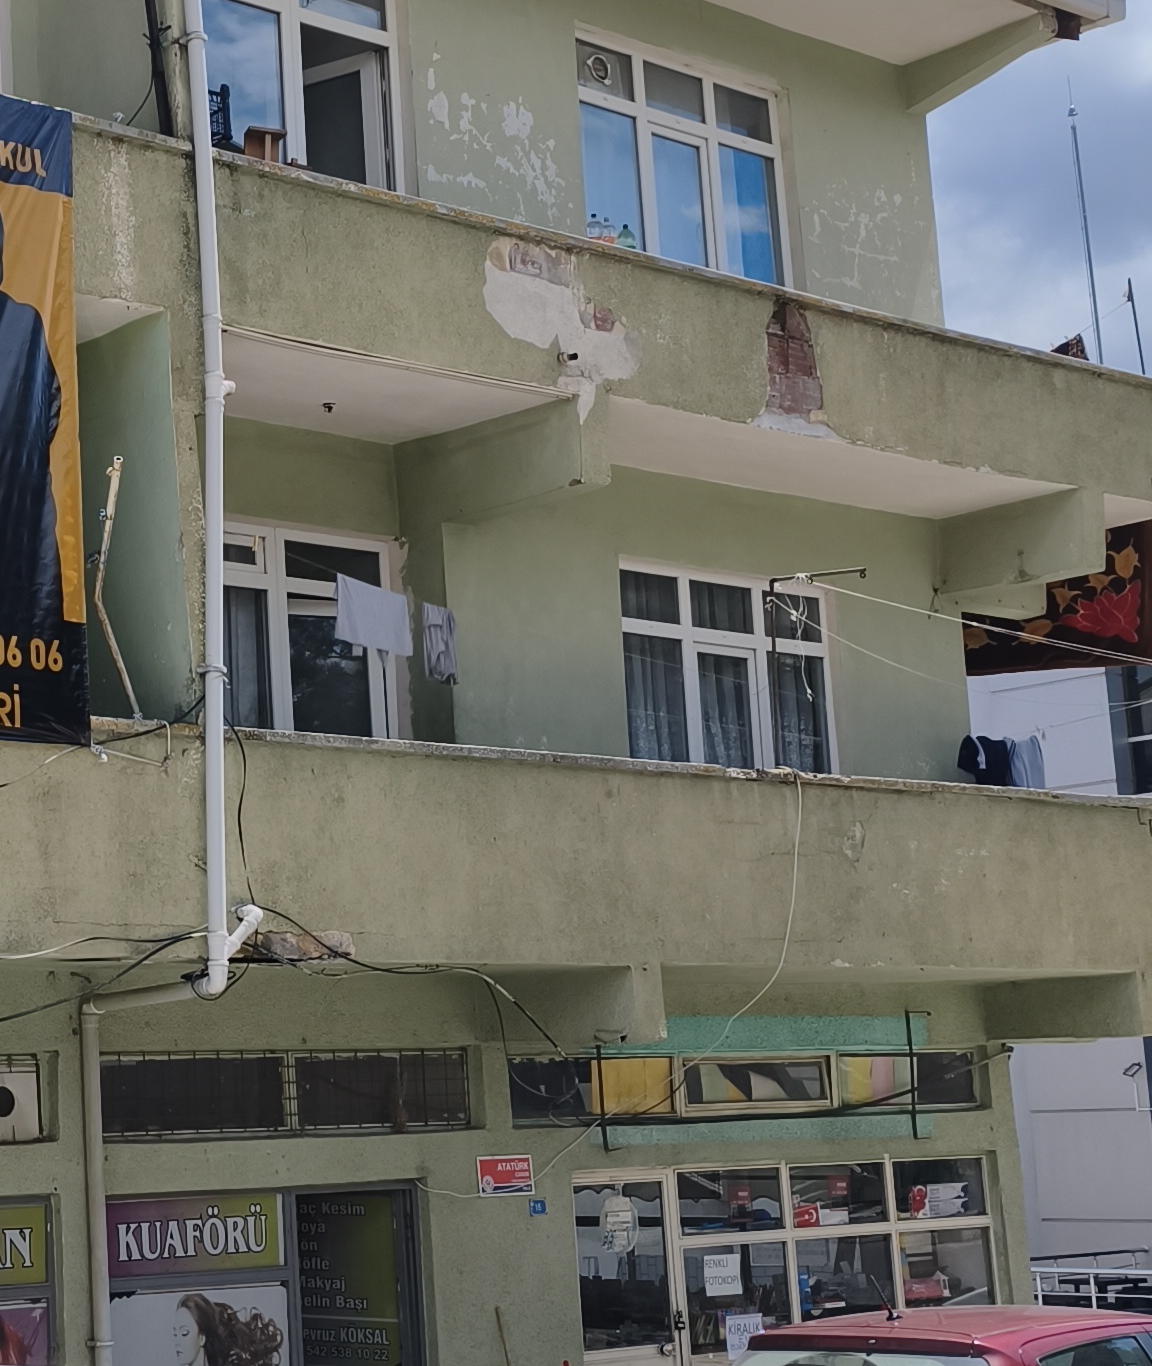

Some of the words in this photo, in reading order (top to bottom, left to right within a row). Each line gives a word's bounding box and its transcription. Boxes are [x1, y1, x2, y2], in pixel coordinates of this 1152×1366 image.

[30, 638, 63, 672] 06
[497, 1160, 529, 1171] ATATÜRK
[298, 1204, 316, 1217] aç
[321, 1201, 365, 1216] Kesim
[117, 1203, 267, 1263] KUAFÖRÜ
[300, 1222, 326, 1235] oya
[300, 1239, 318, 1251] ön
[299, 1256, 330, 1271] öfle
[301, 1295, 331, 1308] elin
[336, 1295, 368, 1313] Başı
[302, 1327, 336, 1342] evruz
[340, 1324, 390, 1345] KÖKSAL
[331, 1347, 353, 1359] 538
[356, 1348, 370, 1360] 10
[374, 1349, 389, 1361] 22
